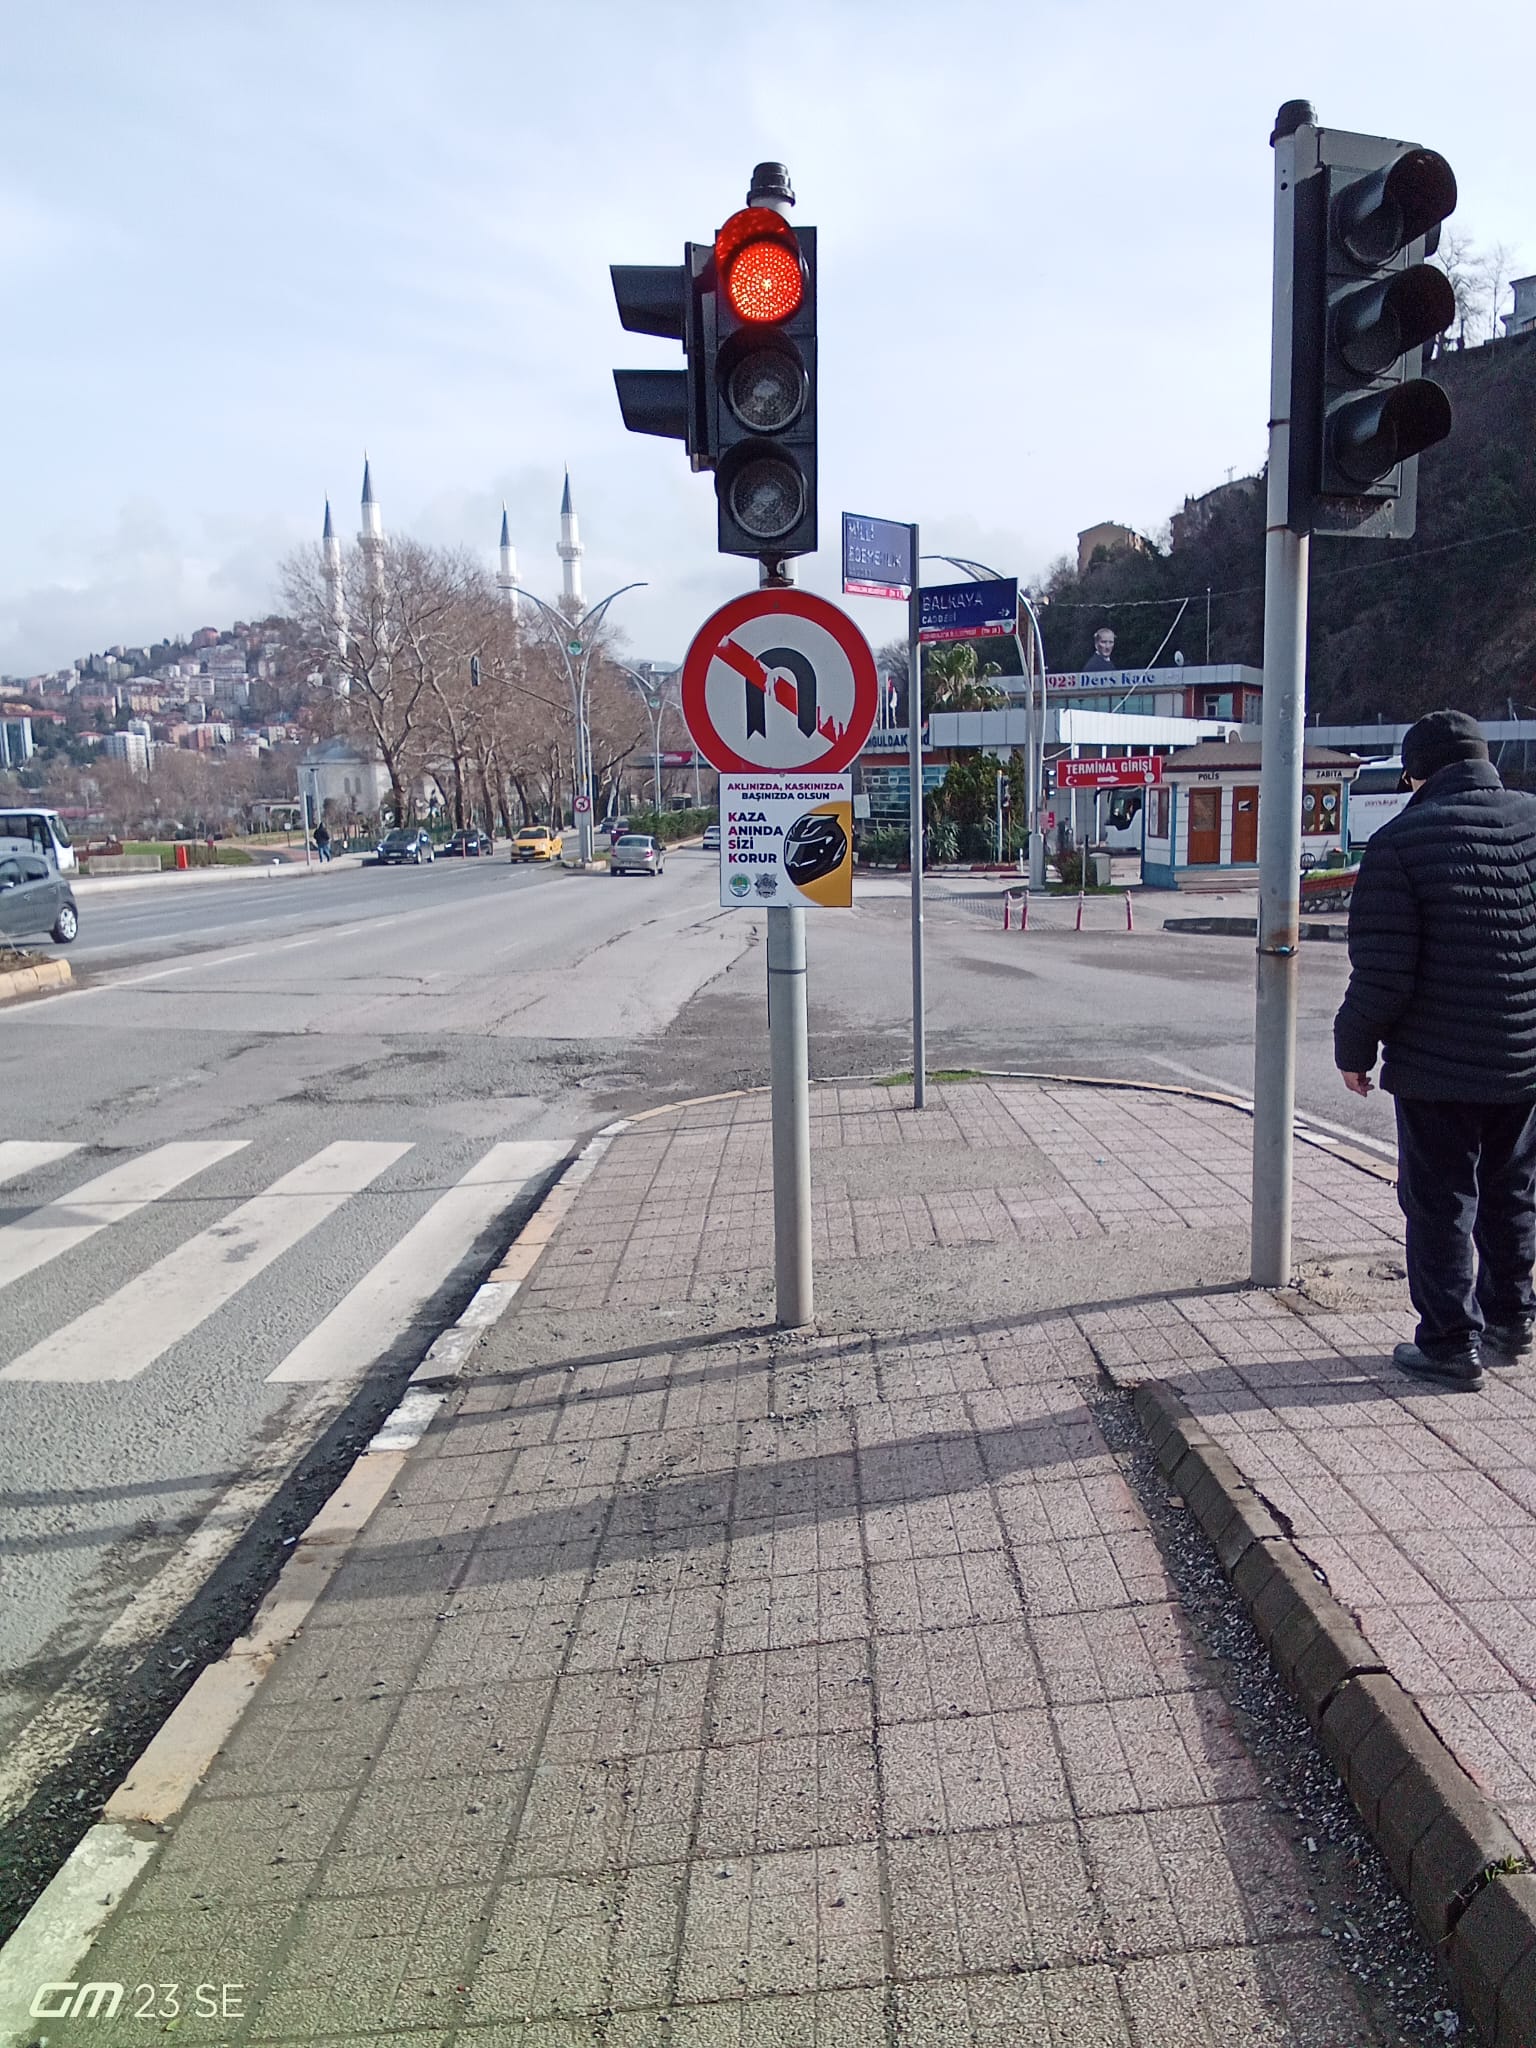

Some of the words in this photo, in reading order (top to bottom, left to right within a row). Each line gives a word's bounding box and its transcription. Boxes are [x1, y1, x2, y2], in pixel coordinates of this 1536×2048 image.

[923, 593, 983, 611] BALKAYA
[1081, 674, 1117, 687] Ders
[1065, 761, 1118, 775] TERMİNAL
[1121, 757, 1153, 773] GİRİŞİ
[1198, 772, 1220, 781] POLİS
[727, 783, 783, 791] AKLINIZDA,
[742, 793, 794, 801] BAŞINIZDA
[797, 792, 830, 800] OLSUN
[728, 812, 767, 822] KAZA
[728, 826, 784, 836] ANINDA
[728, 837, 754, 849] SİZİ
[728, 853, 777, 863] KORUR
